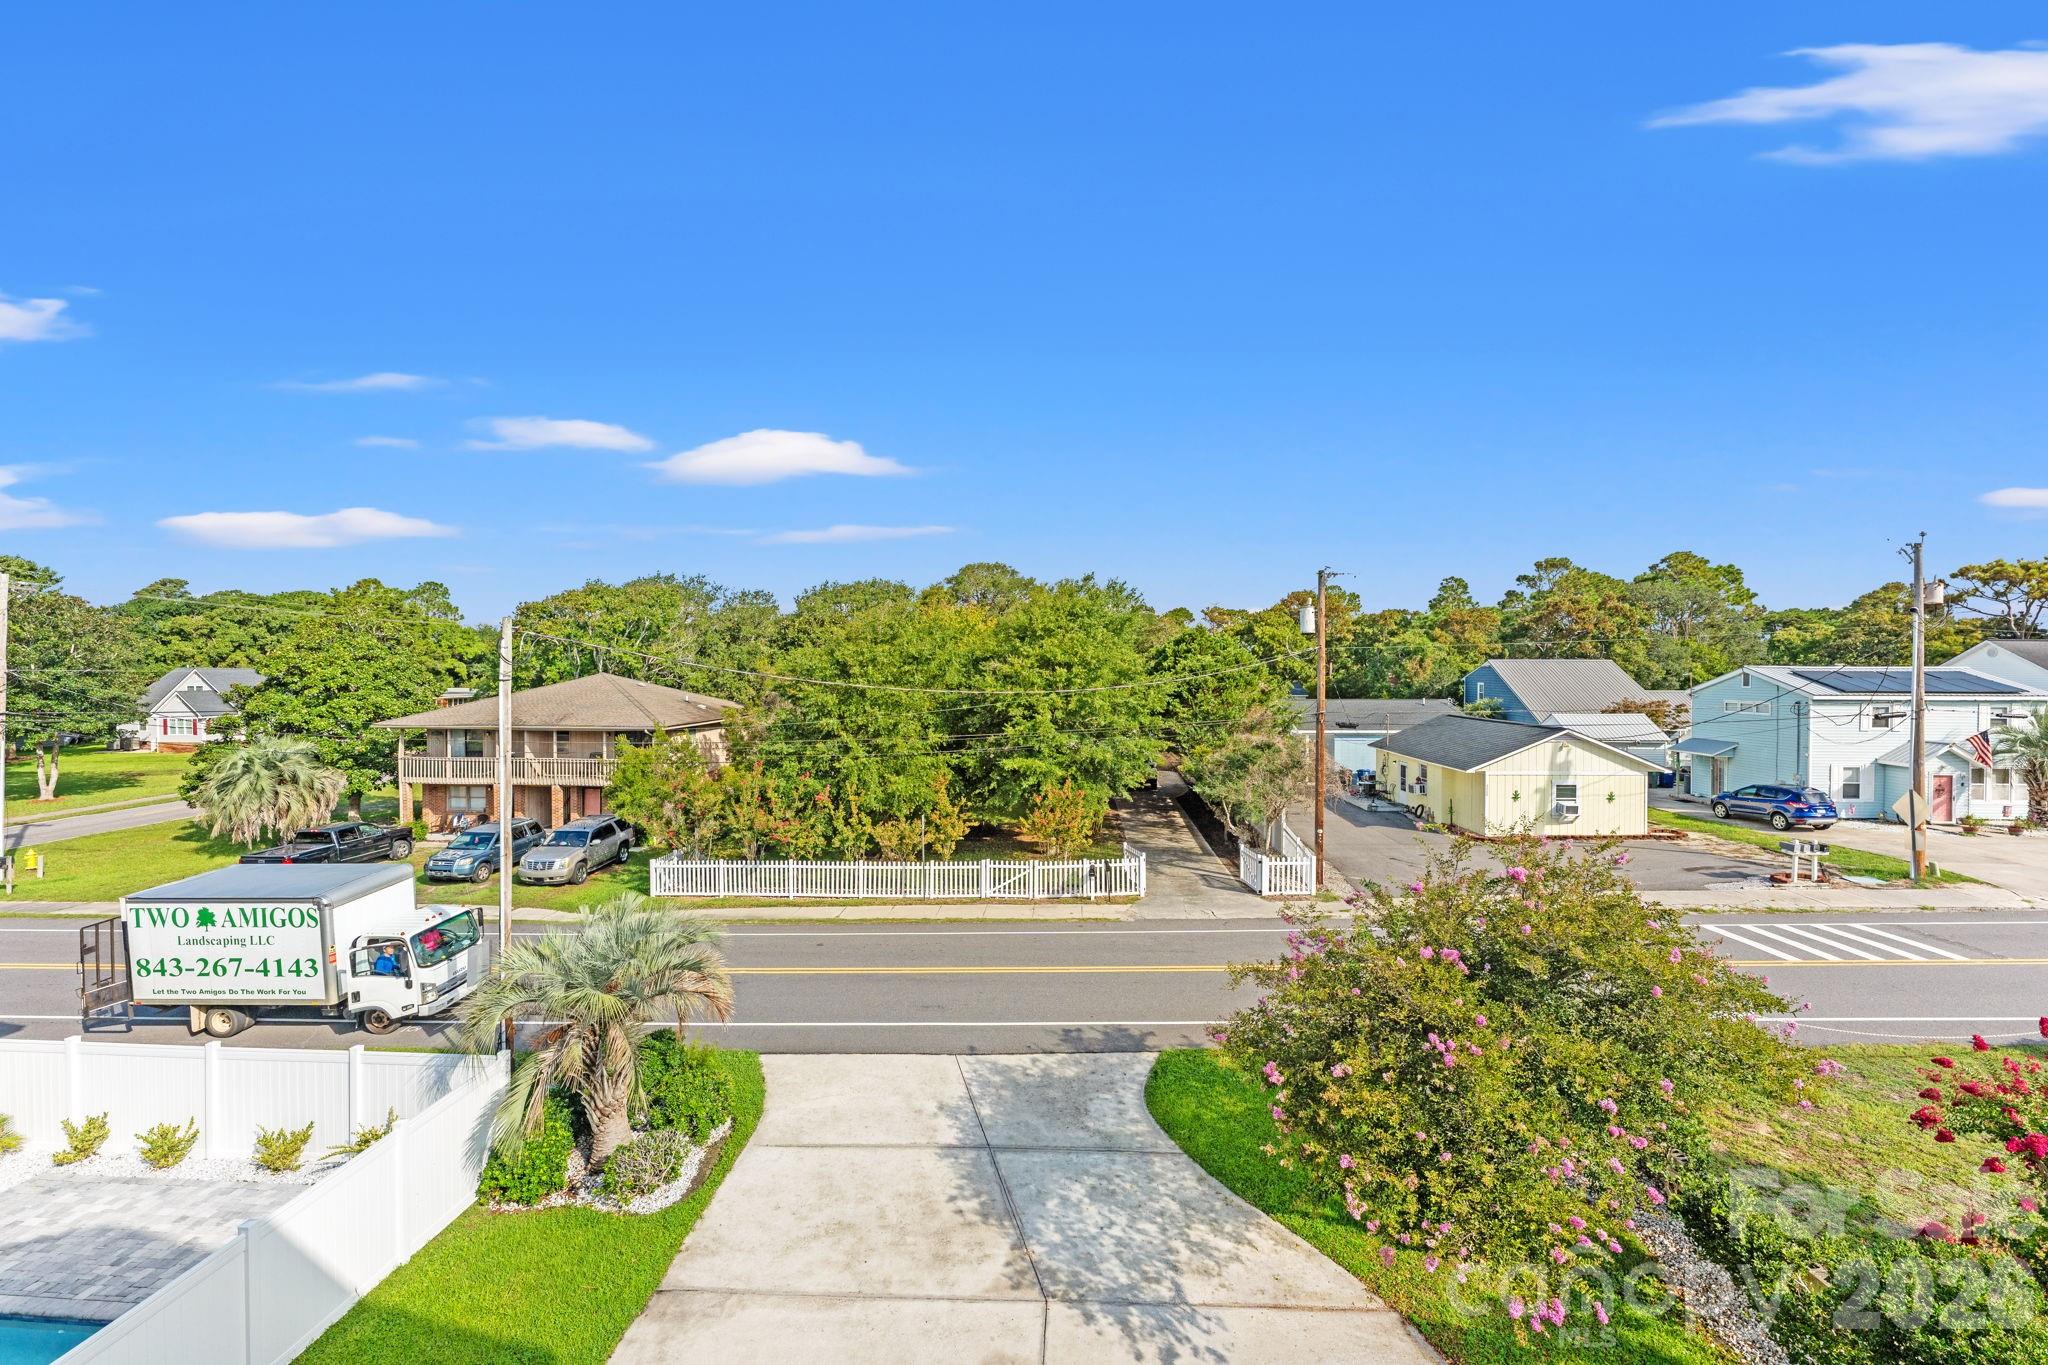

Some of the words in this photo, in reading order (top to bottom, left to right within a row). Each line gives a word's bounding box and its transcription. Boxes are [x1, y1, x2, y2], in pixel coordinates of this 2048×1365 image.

[130, 907, 190, 928] TWO
[221, 907, 319, 928] AMIGOS
[177, 935, 247, 948] Landscaping
[250, 935, 275, 946] LLC
[136, 957, 319, 978] 843-267-4143
[199, 988, 227, 997] Amigos
